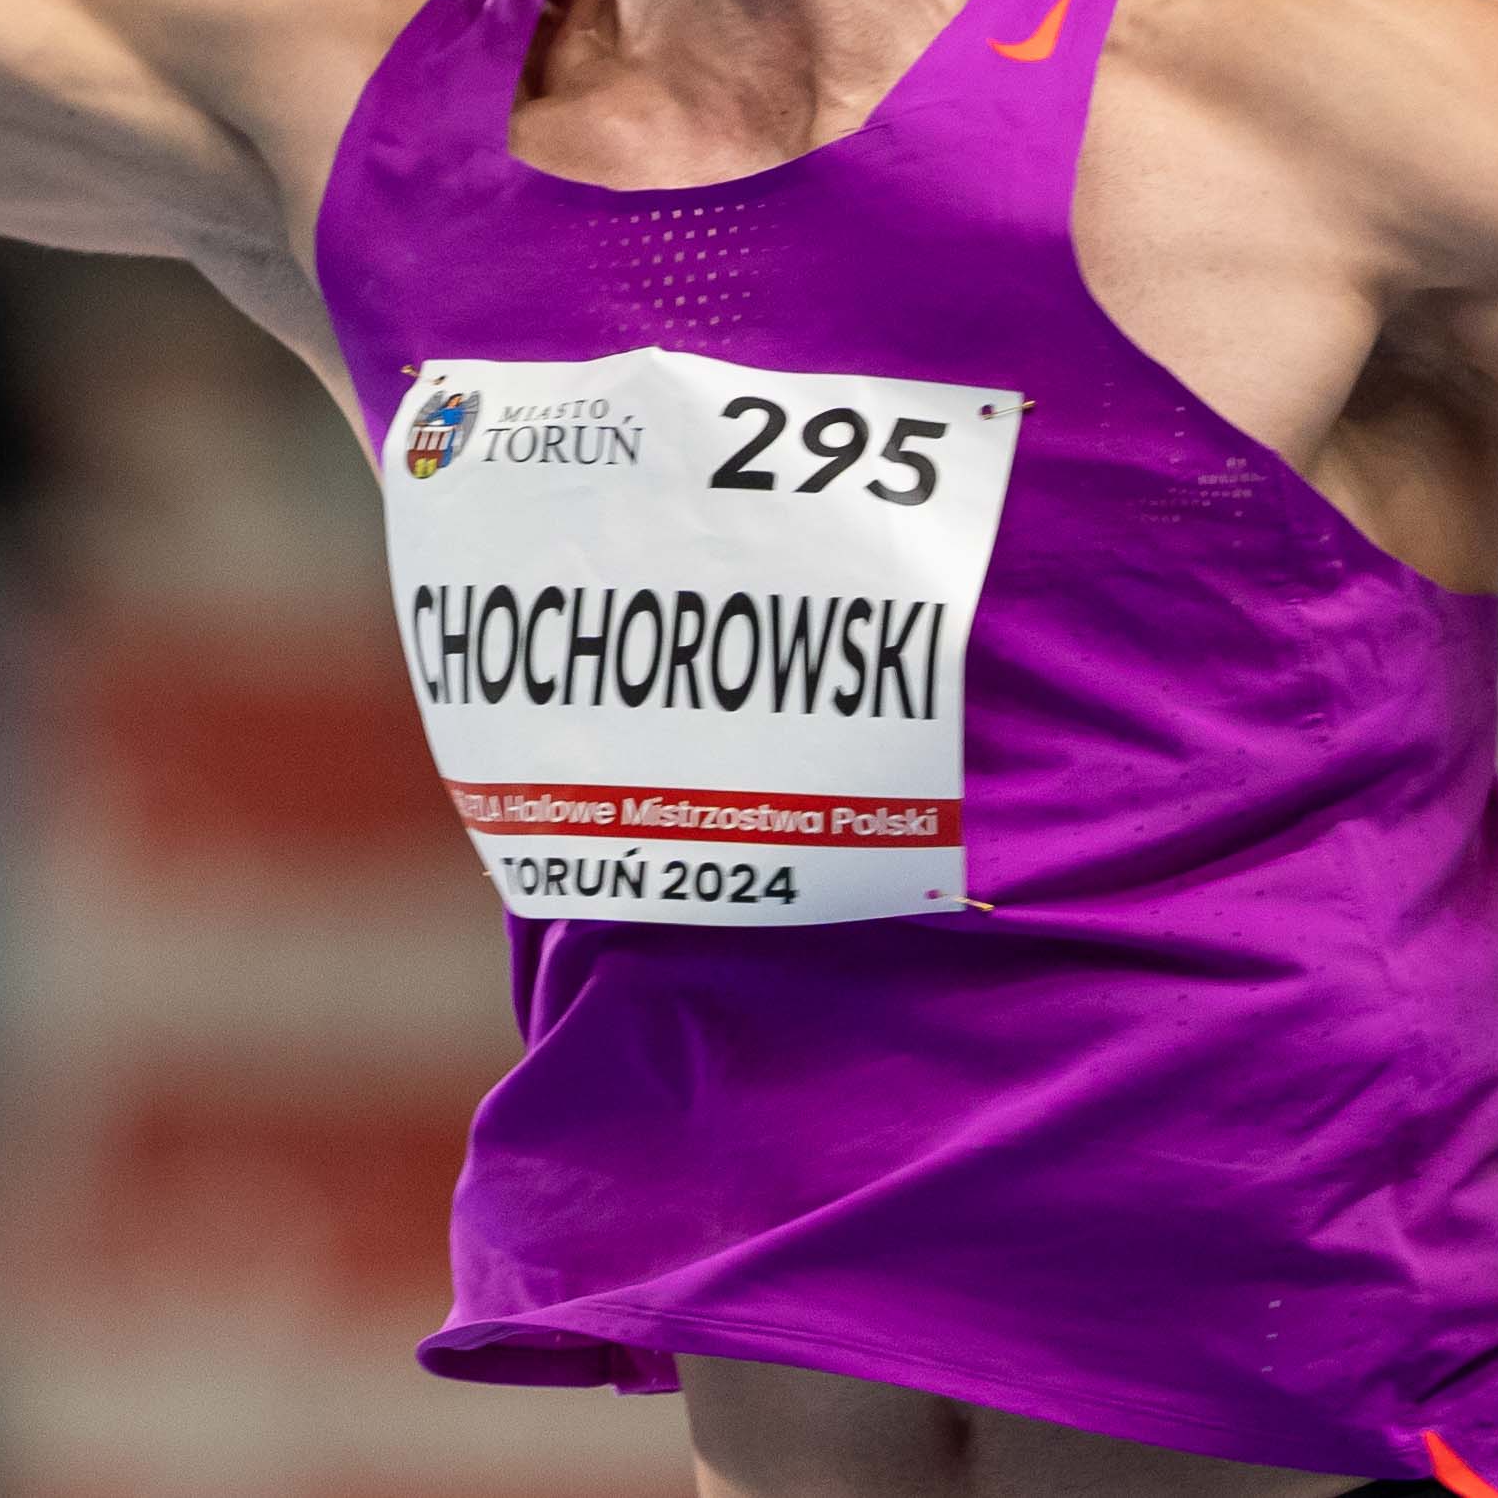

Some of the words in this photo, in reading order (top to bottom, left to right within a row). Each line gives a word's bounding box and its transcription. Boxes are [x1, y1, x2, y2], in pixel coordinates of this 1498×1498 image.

[500, 398, 611, 423] MIASTO
[482, 415, 645, 465] TORUŃ
[709, 395, 949, 506] 295
[412, 584, 946, 720] CHOCHOROWSKI
[504, 793, 616, 824] Halowe
[620, 797, 825, 834] Mistrzostwa
[830, 806, 939, 836] Polski
[500, 847, 648, 899] TORUŃ
[660, 860, 798, 904] 2024
